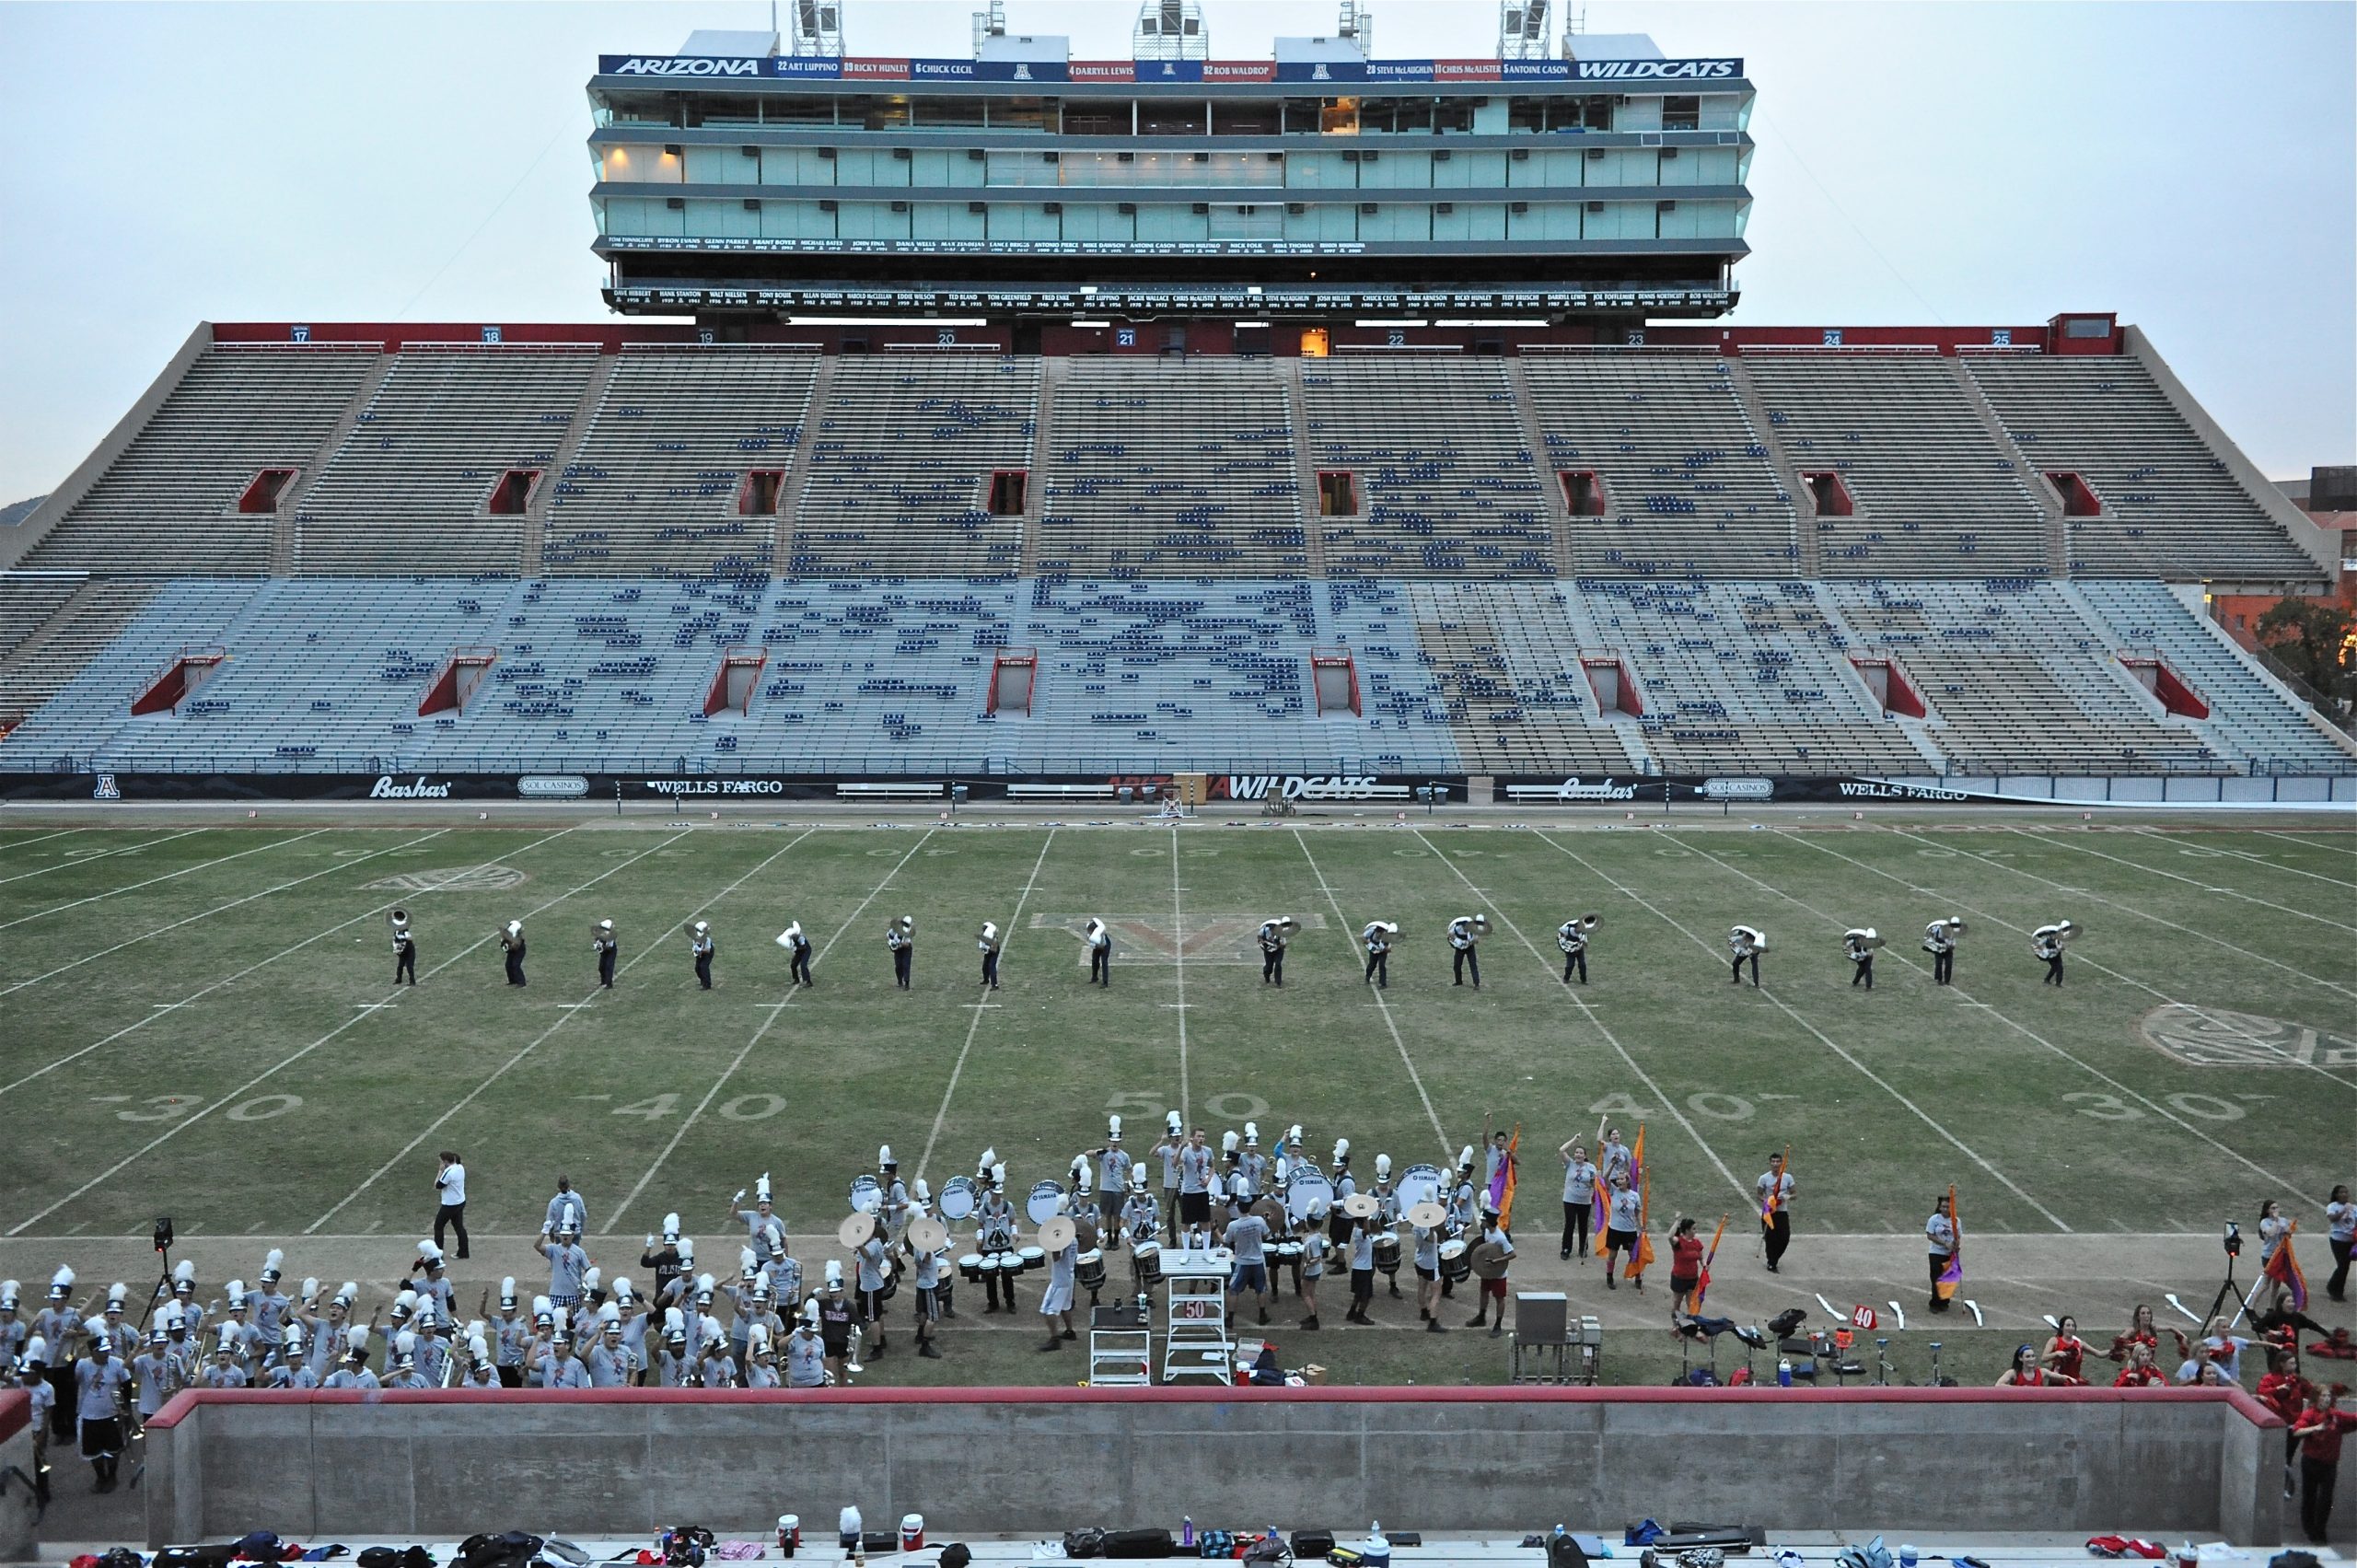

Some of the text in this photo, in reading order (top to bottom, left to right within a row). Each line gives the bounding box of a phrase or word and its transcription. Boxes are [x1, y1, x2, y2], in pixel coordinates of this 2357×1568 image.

[616, 59, 759, 75] ARIZONA
[777, 61, 839, 72] 22 ART LUPPINO
[854, 64, 877, 73] RICKY
[879, 64, 909, 73] HUNLEY
[915, 64, 973, 75] 6 CHUCK CECIL
[1069, 65, 1134, 75] 4 DARRYLL LEWIS
[1203, 65, 1270, 75] 92 ROB WALDROP
[1366, 64, 1434, 75] 28 STEVE McLAUGHLIN
[1443, 65, 1463, 74] CHRIS
[1464, 64, 1502, 74] McALISTER
[1509, 65, 1541, 75] ANTOINE
[1542, 65, 1568, 75] CASON
[1579, 61, 1735, 78] WILDCATS
[295, 331, 308, 343] 17
[485, 332, 499, 343] 18
[700, 333, 714, 344] 19
[939, 334, 955, 344] 20
[1120, 334, 1133, 345] 21
[1389, 335, 1404, 345] 22
[1629, 335, 1644, 345] 23
[1825, 335, 1840, 346] 24
[1993, 335, 2009, 346] 25
[369, 776, 452, 798] Bashas'
[526, 781, 582, 790] SOL CASINOS
[656, 781, 783, 794] WELLS FARGO
[1108, 776, 1230, 799] ARIZA
[1230, 776, 1377, 799] WILDCATS
[1840, 783, 1902, 796] WELLS
[1186, 1301, 1205, 1318] 50
[1855, 1307, 1873, 1328] 40
